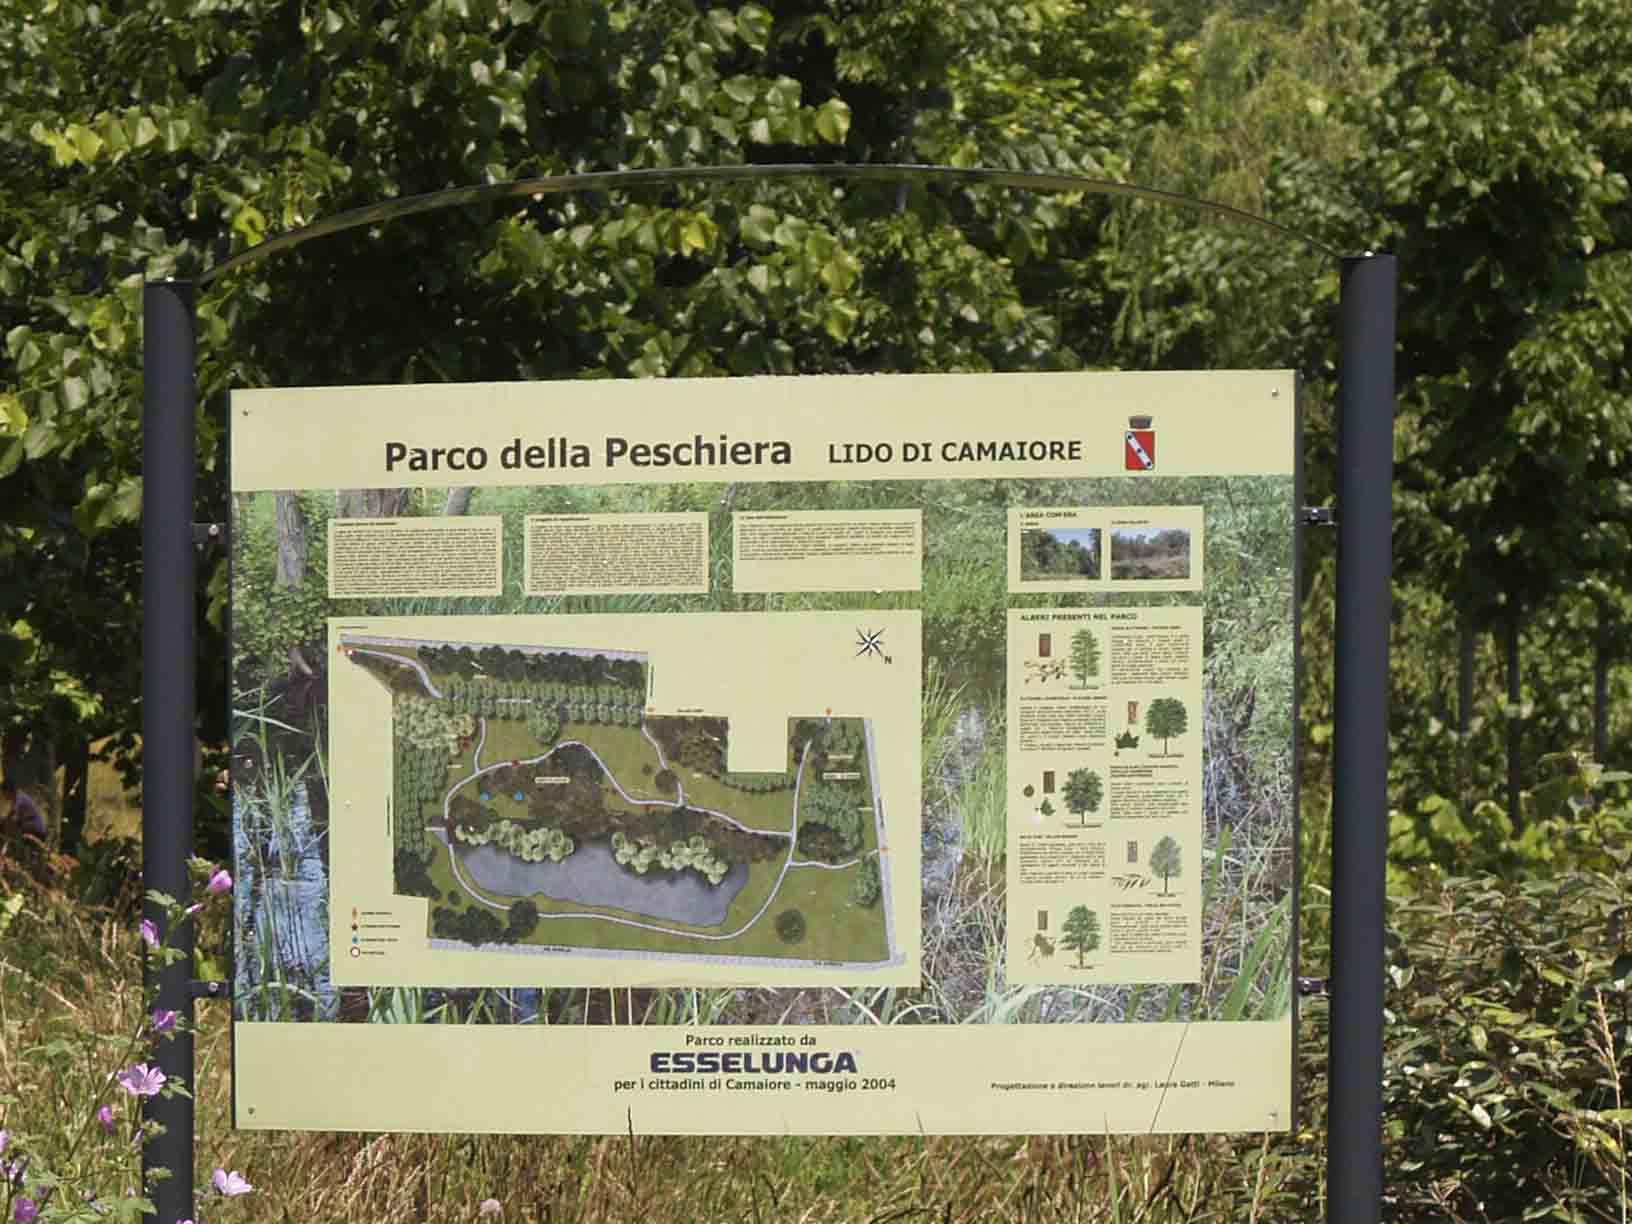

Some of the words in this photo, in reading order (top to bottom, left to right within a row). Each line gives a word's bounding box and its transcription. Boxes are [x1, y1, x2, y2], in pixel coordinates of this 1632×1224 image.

[385, 441, 489, 473] Parco
[499, 436, 591, 470] della
[604, 433, 792, 468] Peschiera
[828, 442, 895, 464] LIDO
[902, 441, 933, 463] DI
[940, 439, 1083, 463] CAMAIORE
[1051, 612, 1092, 621] PRESENTI
[1093, 612, 1108, 621] NEL
[1109, 611, 1138, 620] PARCO
[883, 655, 893, 665] N
[685, 1034, 725, 1047] Parco
[727, 1033, 796, 1047] realizzato
[799, 1033, 817, 1047] da
[650, 1052, 858, 1074] ESSELUNGA
[613, 1079, 637, 1094] per
[639, 1078, 645, 1091] i
[647, 1077, 705, 1091] cittadini
[708, 1077, 722, 1091] di
[725, 1077, 792, 1092] Camaiore
[804, 1077, 857, 1094] maggio
[860, 1077, 897, 1091] 2004
